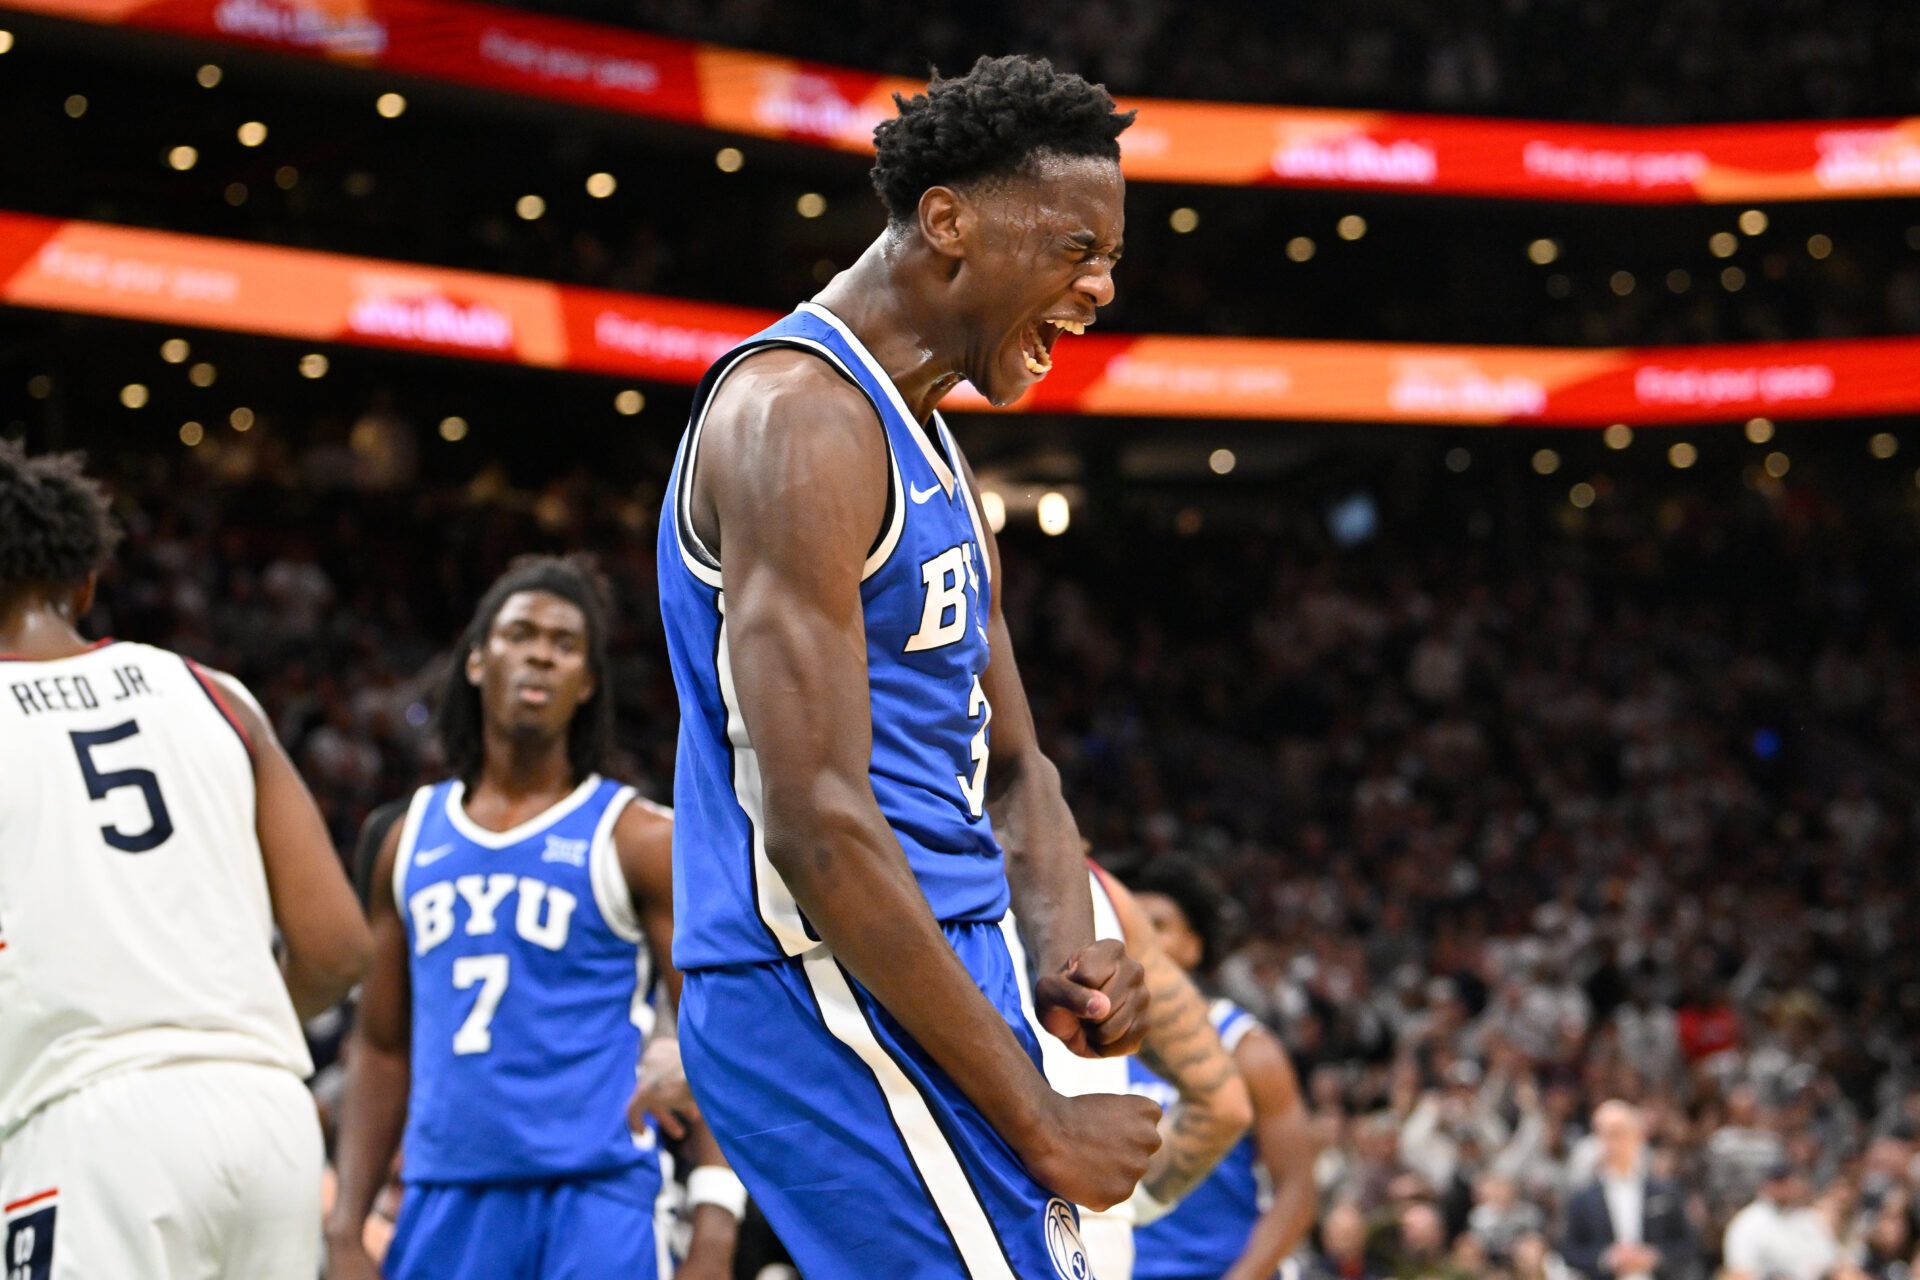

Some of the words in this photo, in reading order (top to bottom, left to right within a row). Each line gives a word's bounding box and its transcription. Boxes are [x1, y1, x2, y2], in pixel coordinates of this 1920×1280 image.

[10, 674, 101, 716] REED
[956, 672, 992, 820] 3
[68, 718, 175, 854] 5
[409, 873, 577, 957] BYU
[453, 953, 509, 1056] 7
